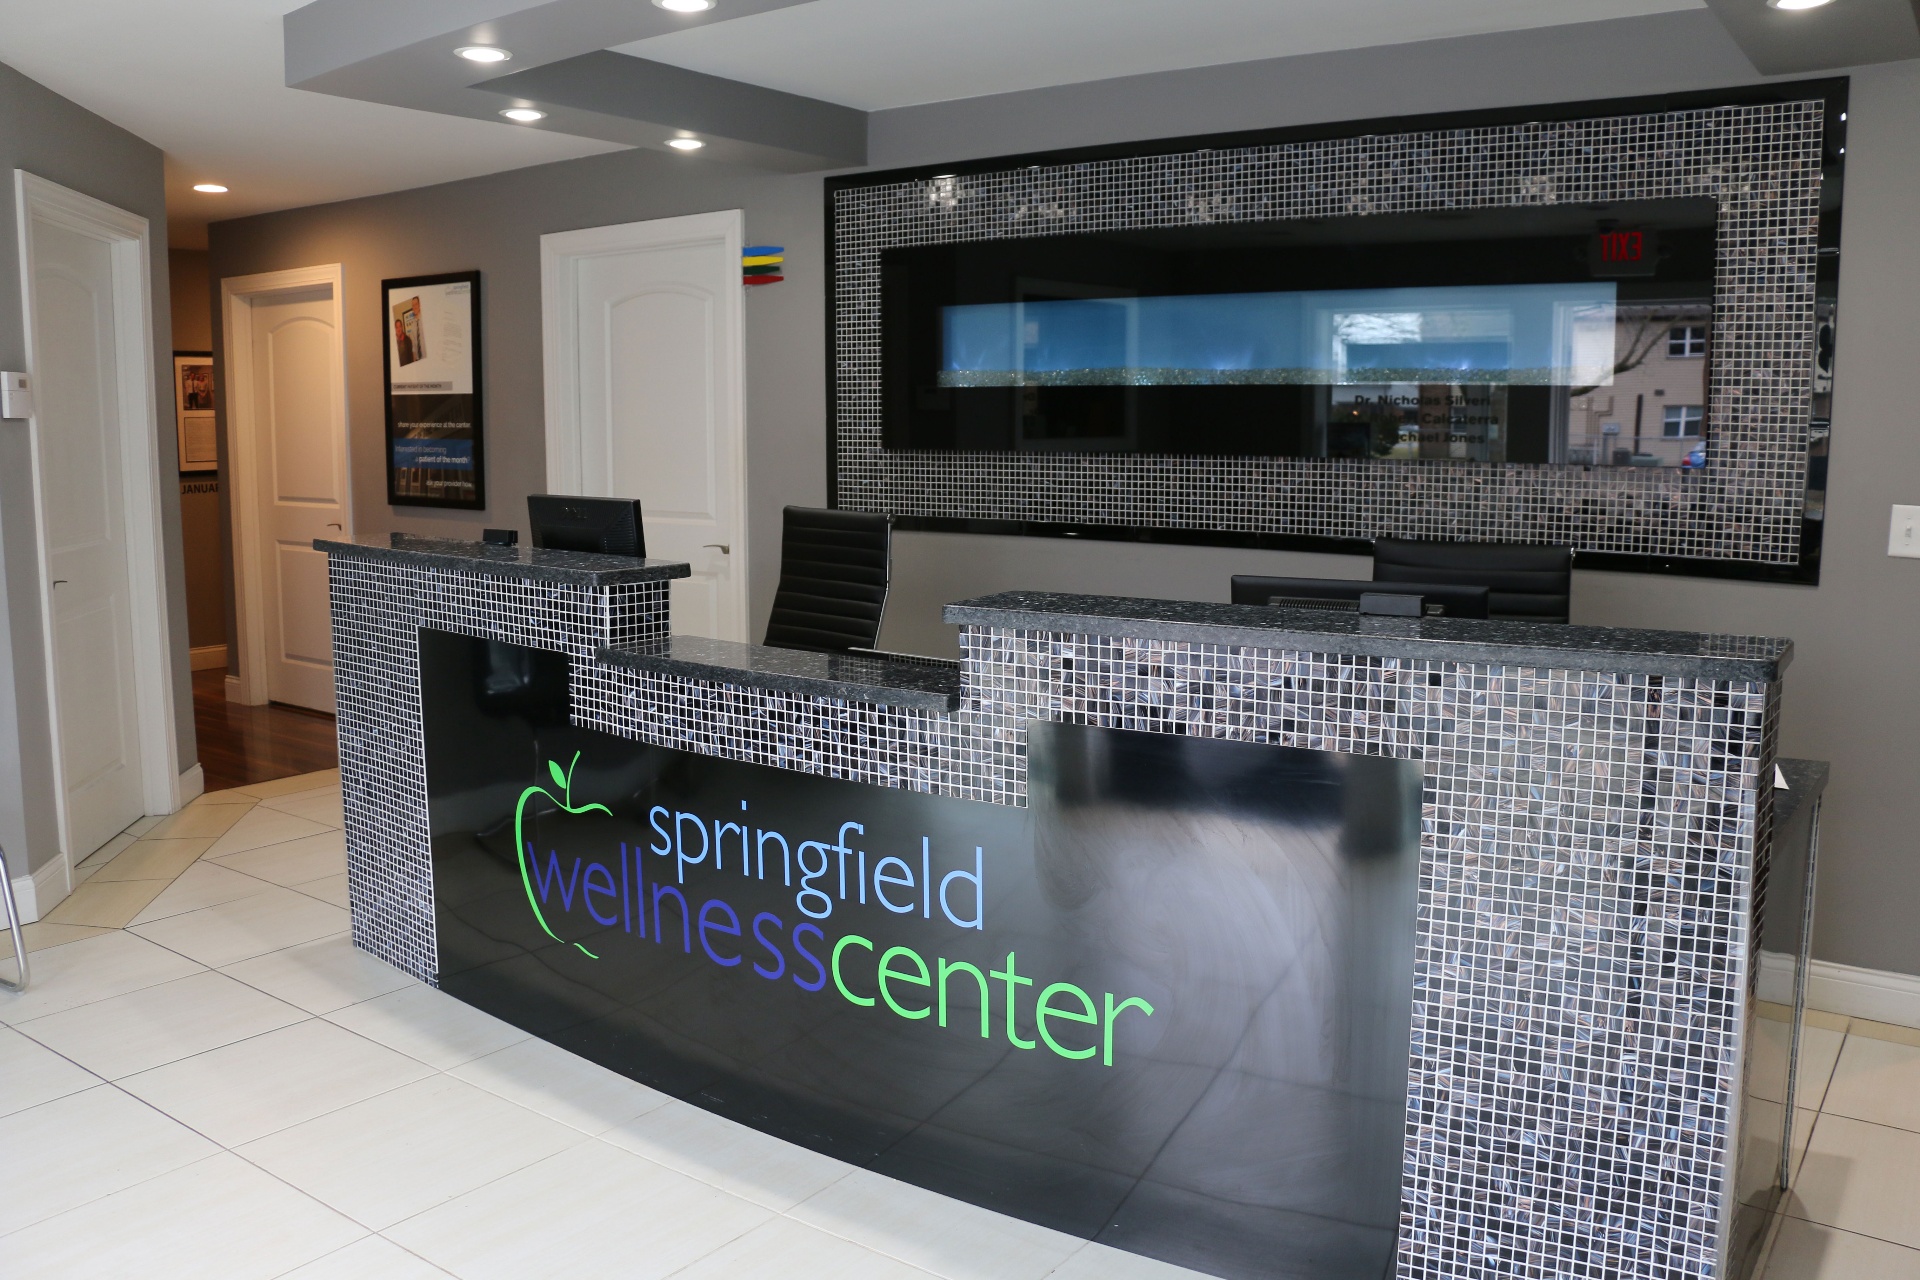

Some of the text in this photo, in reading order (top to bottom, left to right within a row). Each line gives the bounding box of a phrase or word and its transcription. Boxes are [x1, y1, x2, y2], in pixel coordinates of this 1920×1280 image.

[1378, 394, 1440, 407] Nicholas
[1443, 432, 1485, 445] Jones
[423, 446, 447, 455] becoming
[419, 456, 436, 464] patient
[444, 480, 462, 488] provider
[649, 800, 983, 931] springfield
